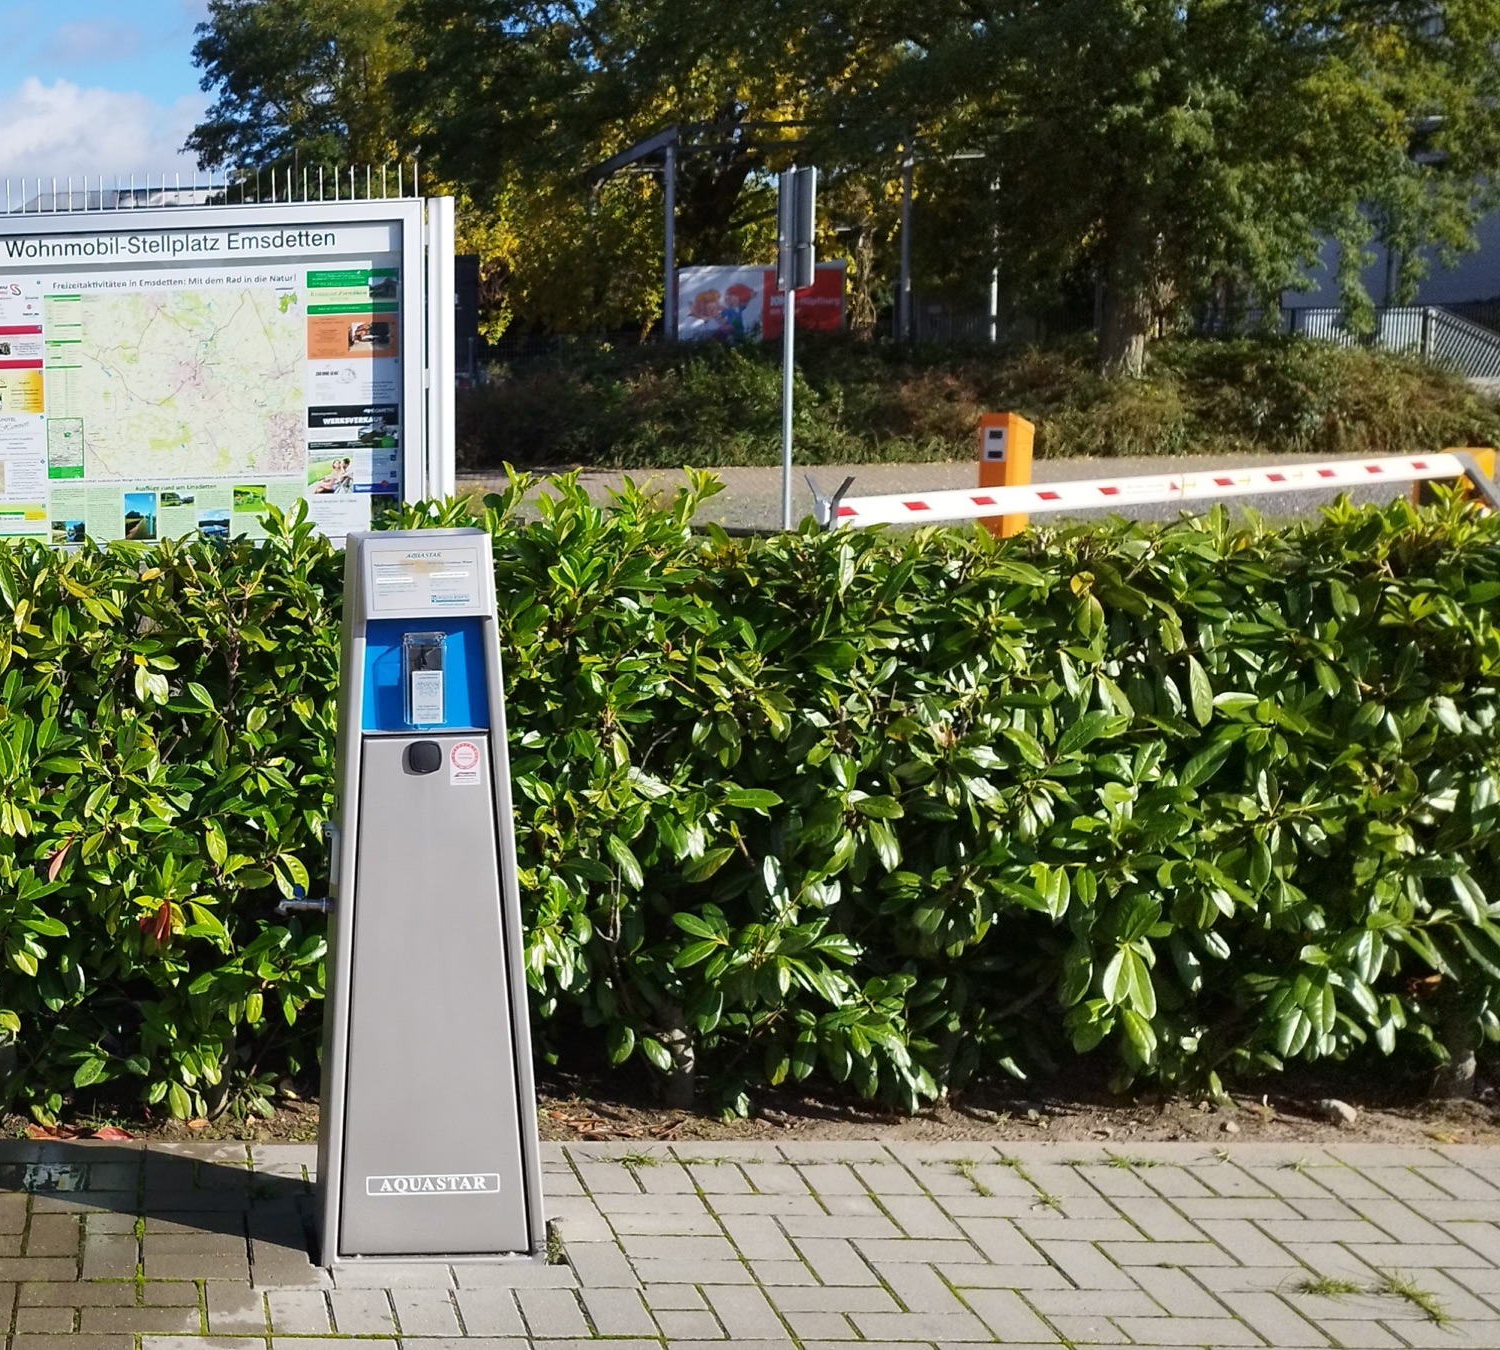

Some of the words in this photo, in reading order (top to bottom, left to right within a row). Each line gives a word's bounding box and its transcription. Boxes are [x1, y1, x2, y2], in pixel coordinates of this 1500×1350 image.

[5, 234, 220, 258] Wohnmobil-Stellplatz
[227, 230, 336, 250] Emsdetten
[52, 280, 127, 290] Freizeitaktivitäten
[129, 279, 137, 287] in
[139, 278, 186, 287] Emsdetten:
[188, 277, 203, 285] Mit
[205, 277, 224, 285] dem
[226, 275, 242, 284] Rad
[244, 275, 252, 283] in
[254, 274, 268, 283] die
[269, 273, 297, 283] Natur!
[380, 1176, 487, 1193] AQUASTAR
